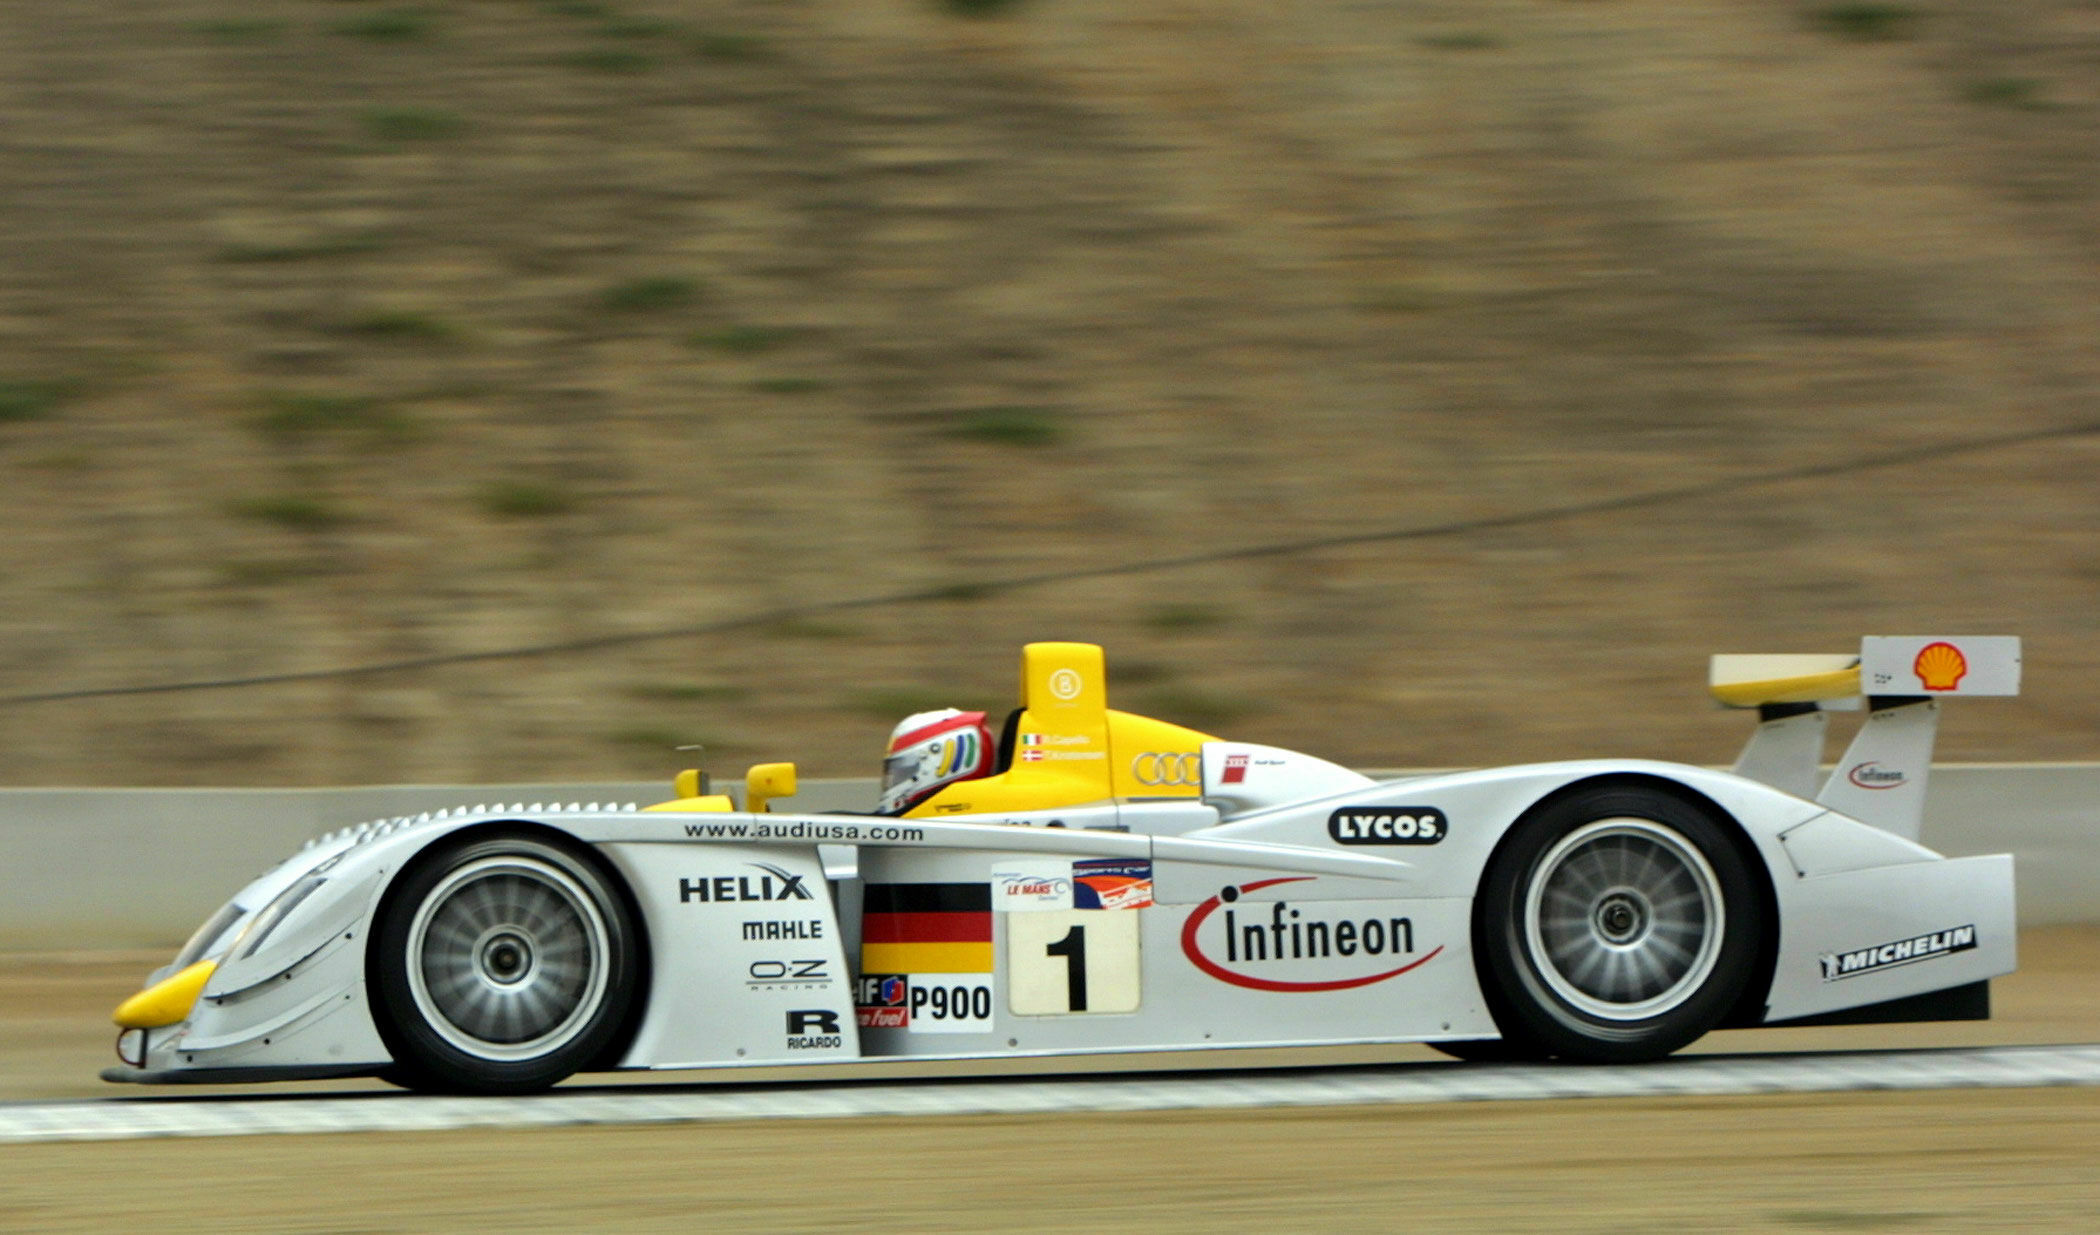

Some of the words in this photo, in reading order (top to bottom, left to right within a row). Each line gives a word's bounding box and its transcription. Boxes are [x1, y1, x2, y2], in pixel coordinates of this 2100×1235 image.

[684, 822, 924, 841] www.audiusa.com
[1339, 815, 1436, 838] LYCOS
[679, 874, 813, 903] HELIX
[1007, 885, 1019, 896] LE
[1022, 883, 1052, 896] MANS
[743, 921, 823, 941] MAHLE
[1842, 926, 1974, 972] MICHELIN
[1046, 925, 1087, 1011] 1
[911, 986, 990, 1020] P900
[786, 1010, 840, 1035] R
[870, 1009, 905, 1027] fuel
[787, 1037, 841, 1049] RICARDO
